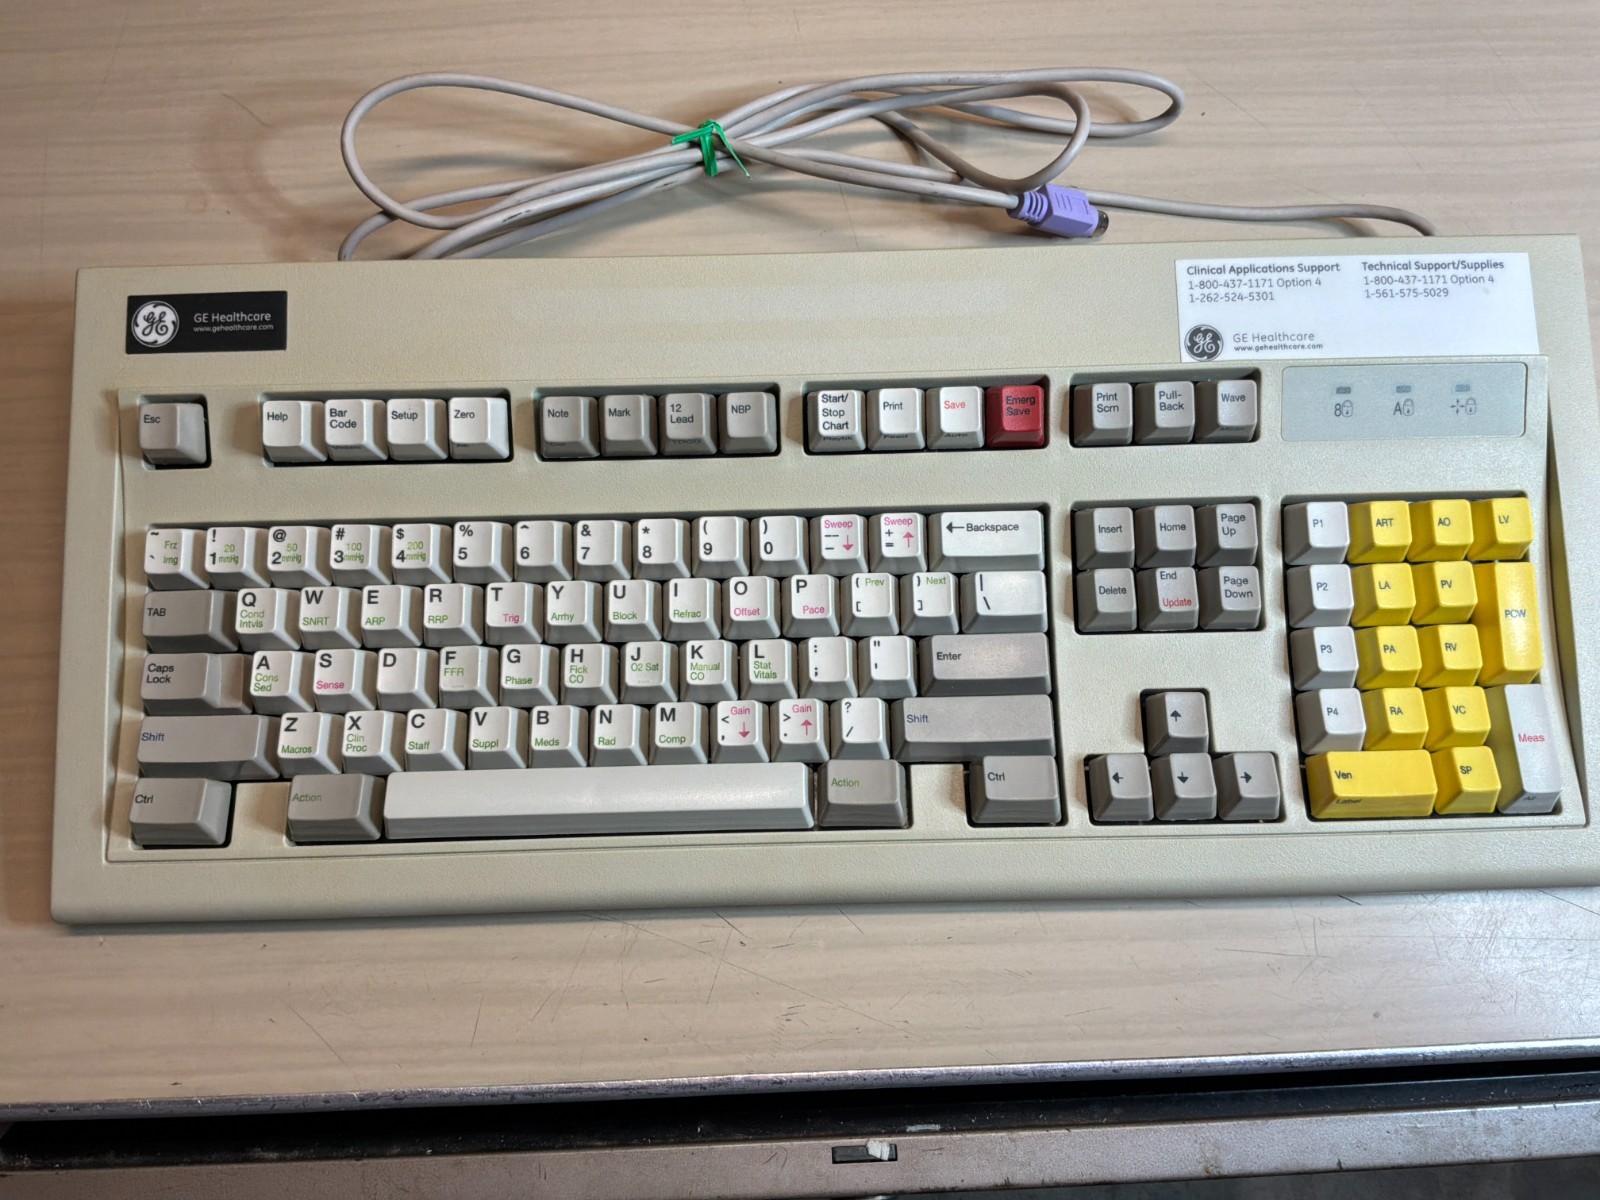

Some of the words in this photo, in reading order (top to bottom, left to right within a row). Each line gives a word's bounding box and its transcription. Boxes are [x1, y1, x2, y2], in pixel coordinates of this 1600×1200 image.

[1187, 264, 1226, 275] Clinical
[1229, 265, 1295, 276] Applications
[1297, 263, 1340, 274] Support
[1362, 261, 1411, 271] Technical
[1414, 260, 1504, 271] Support/Supplies
[1188, 279, 1272, 290] 1-800-437-1171
[1277, 278, 1312, 288] Option
[1315, 278, 1322, 286] 4
[1364, 275, 1448, 285] 1-800-437-1171
[1450, 275, 1485, 286] Option
[1488, 275, 1494, 283] 4
[1189, 292, 1274, 303] 1-262-524-5301
[1365, 288, 1449, 298] 1-561-575-5029
[194, 313, 208, 322] GE
[211, 311, 271, 322] Healthcare
[193, 323, 274, 332] www.gehealthcare.com
[1233, 334, 1248, 342] GE
[1252, 332, 1314, 342] Healthcare
[1234, 343, 1323, 352] www.gehealthcare.com
[822, 394, 849, 403] Start/
[1096, 392, 1117, 401] Print
[1159, 391, 1182, 399] Pull-
[1221, 393, 1245, 402] Wave
[1006, 395, 1035, 405] Emerg
[670, 404, 681, 412] 12
[731, 405, 751, 414] NBP
[883, 402, 903, 410] Print
[944, 401, 966, 409] Save
[1097, 404, 1119, 412] Scrn
[1159, 402, 1184, 411] Back
[330, 408, 347, 418] Bar
[454, 410, 475, 419] Zero
[547, 409, 569, 418] Note
[608, 408, 630, 417] Mark
[822, 408, 845, 418] Stop
[1006, 407, 1030, 415] Save
[143, 414, 160, 424] Esc
[267, 412, 288, 422] Help
[391, 411, 418, 421] Setup
[670, 414, 693, 423] Lead
[330, 419, 357, 429] Code
[822, 421, 849, 430] Chart
[884, 517, 913, 526] Sweep
[1221, 514, 1246, 524] Page
[1313, 519, 1324, 527] P1
[1376, 518, 1394, 526] ART
[1438, 518, 1450, 526] AO
[1499, 515, 1509, 524] LV
[825, 520, 853, 529] Sweep
[966, 523, 1019, 532] Backspace
[1098, 525, 1122, 533] Insert
[1222, 527, 1236, 536] Up
[165, 541, 177, 549] Frz
[224, 544, 235, 552] 20
[287, 543, 297, 551] 50
[346, 543, 362, 551] 100
[219, 555, 239, 564] mmHg
[282, 554, 301, 563] mmHg
[344, 554, 364, 562] mmHg
[865, 578, 885, 586] Prev
[926, 577, 946, 585] Next
[1224, 577, 1248, 586] Page
[1441, 580, 1452, 588] PV
[734, 581, 747, 595] O
[796, 579, 807, 593] P
[1317, 583, 1327, 591] P2
[1379, 582, 1391, 590] LA
[430, 589, 442, 602] R
[491, 588, 503, 601] T
[551, 586, 564, 599] Y
[613, 585, 626, 598] U
[1099, 587, 1127, 595] Delete
[1225, 590, 1253, 598] Down
[242, 593, 257, 606] Q
[305, 590, 323, 604] W
[367, 590, 379, 604] E
[1163, 599, 1192, 608] Update
[148, 608, 166, 616] TAB
[240, 610, 265, 618] Cond
[674, 610, 701, 618] Refrac
[734, 607, 760, 616] Offset
[803, 606, 824, 614] Pace
[1505, 609, 1527, 618] PCW
[428, 615, 448, 623] RRP
[503, 614, 519, 623] Trig
[551, 613, 574, 621] Arrhy
[613, 612, 637, 620] Block
[240, 620, 263, 628] Intvls
[303, 617, 329, 625] SNRT
[365, 617, 385, 625] ARP
[755, 645, 764, 658] L
[1321, 645, 1332, 653] P3
[1384, 645, 1396, 653] PA
[1445, 643, 1457, 651] RV
[507, 649, 521, 663] G
[571, 649, 583, 663] H
[631, 647, 640, 661] J
[691, 645, 703, 659] K
[937, 652, 961, 661] Enter
[319, 654, 332, 668] S
[383, 653, 397, 667] D
[446, 651, 457, 665] F
[256, 656, 270, 670] A
[645, 663, 659, 671] Sat
[690, 662, 720, 671] Manual
[754, 661, 771, 670] Stat
[148, 663, 174, 673] Caps
[444, 668, 464, 676] FFR
[570, 665, 588, 674] Fick
[255, 673, 279, 682] Cons
[569, 675, 584, 683] CO
[690, 672, 704, 680] CO
[754, 670, 777, 679] Vitals
[146, 675, 171, 684] Lock
[505, 676, 532, 685] Phase
[253, 683, 272, 692] Sed
[316, 681, 344, 689] Sense
[731, 707, 750, 715] Gain
[792, 705, 812, 713] Gain
[1327, 708, 1338, 716] P4
[1390, 707, 1403, 715] RA
[1453, 706, 1466, 714] VC
[475, 712, 487, 726] V
[537, 711, 549, 724] B
[600, 710, 612, 723] N
[661, 708, 676, 721] M
[907, 714, 928, 723] Shift
[284, 718, 298, 731] Z
[348, 717, 362, 730] X
[411, 714, 425, 728] C
[141, 733, 165, 741] Shift
[347, 734, 364, 742] Clin
[598, 737, 616, 746] Rad
[659, 735, 686, 744] Comp
[1518, 733, 1545, 742] Meas
[408, 741, 430, 750] Staff
[472, 740, 499, 748] Suppl
[535, 738, 559, 746] Meds
[281, 745, 312, 754] Macros
[346, 744, 367, 752] Proc
[1335, 770, 1352, 779] Ven
[1460, 766, 1472, 774] SP
[988, 772, 1005, 781] Ctrl
[831, 778, 859, 787] Action
[135, 795, 153, 803] Ctrl
[292, 793, 322, 802] Action
